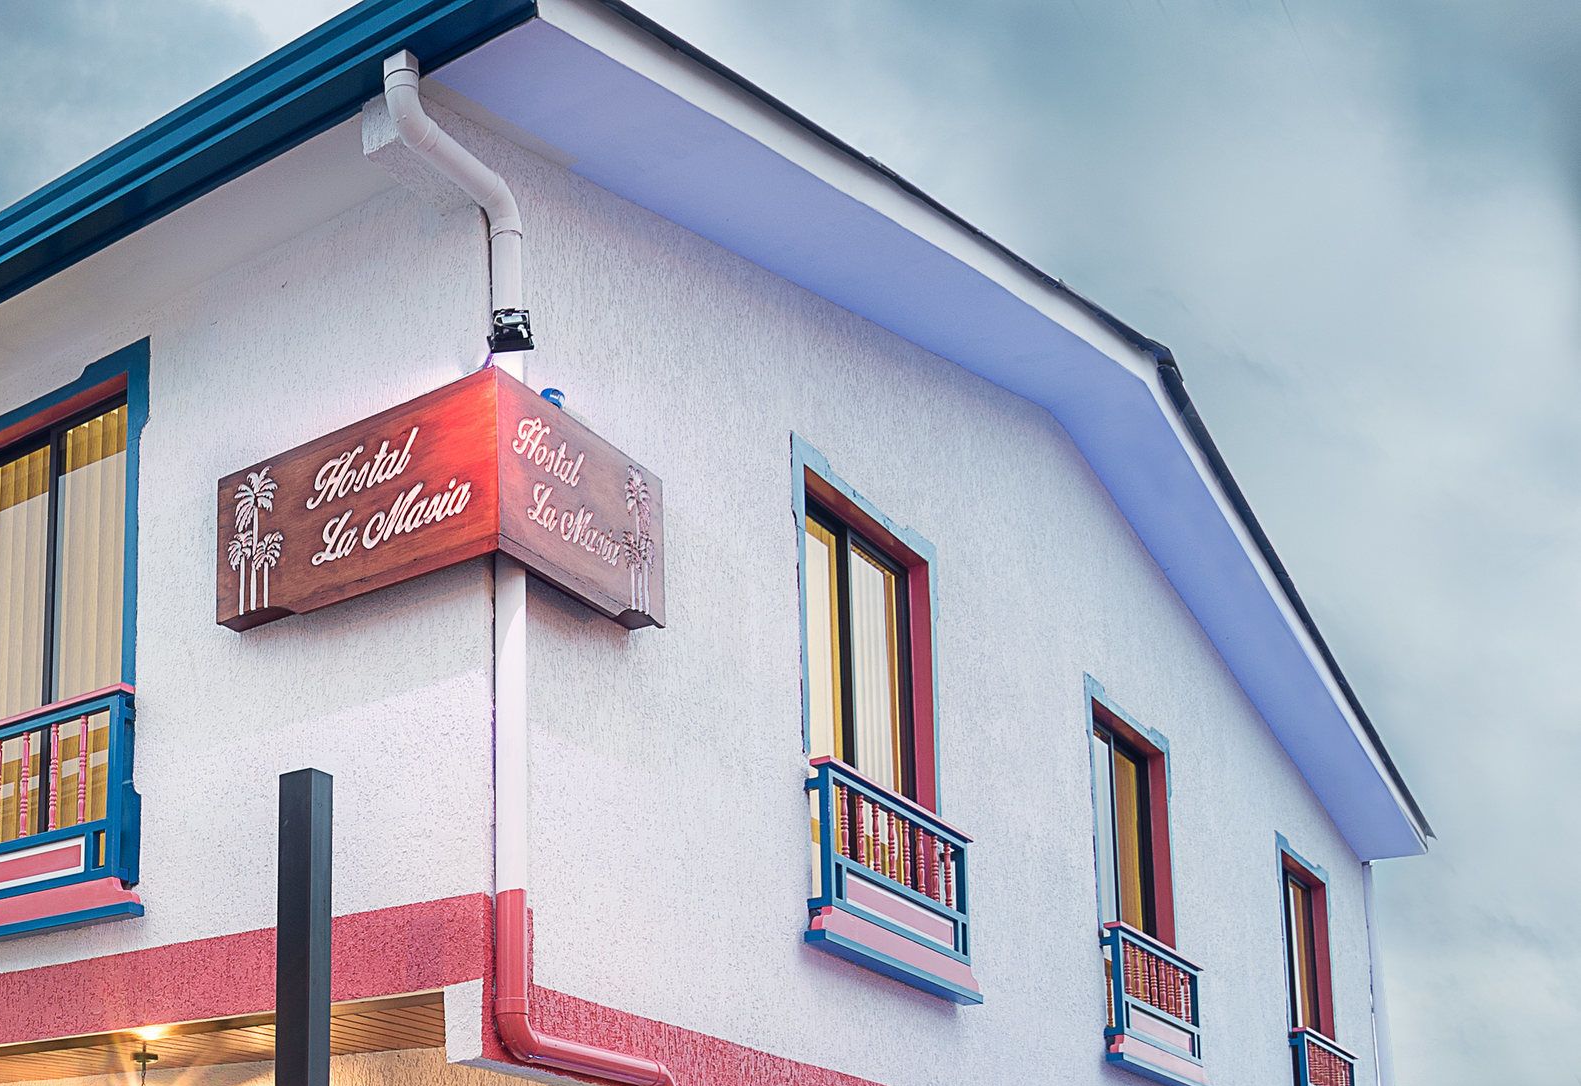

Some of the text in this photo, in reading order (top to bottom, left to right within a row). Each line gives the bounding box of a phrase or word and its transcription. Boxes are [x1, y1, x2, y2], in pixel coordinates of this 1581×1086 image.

[306, 426, 420, 510] Hostal
[512, 416, 585, 487] Hostal
[311, 509, 359, 566] La
[527, 481, 558, 532] La
